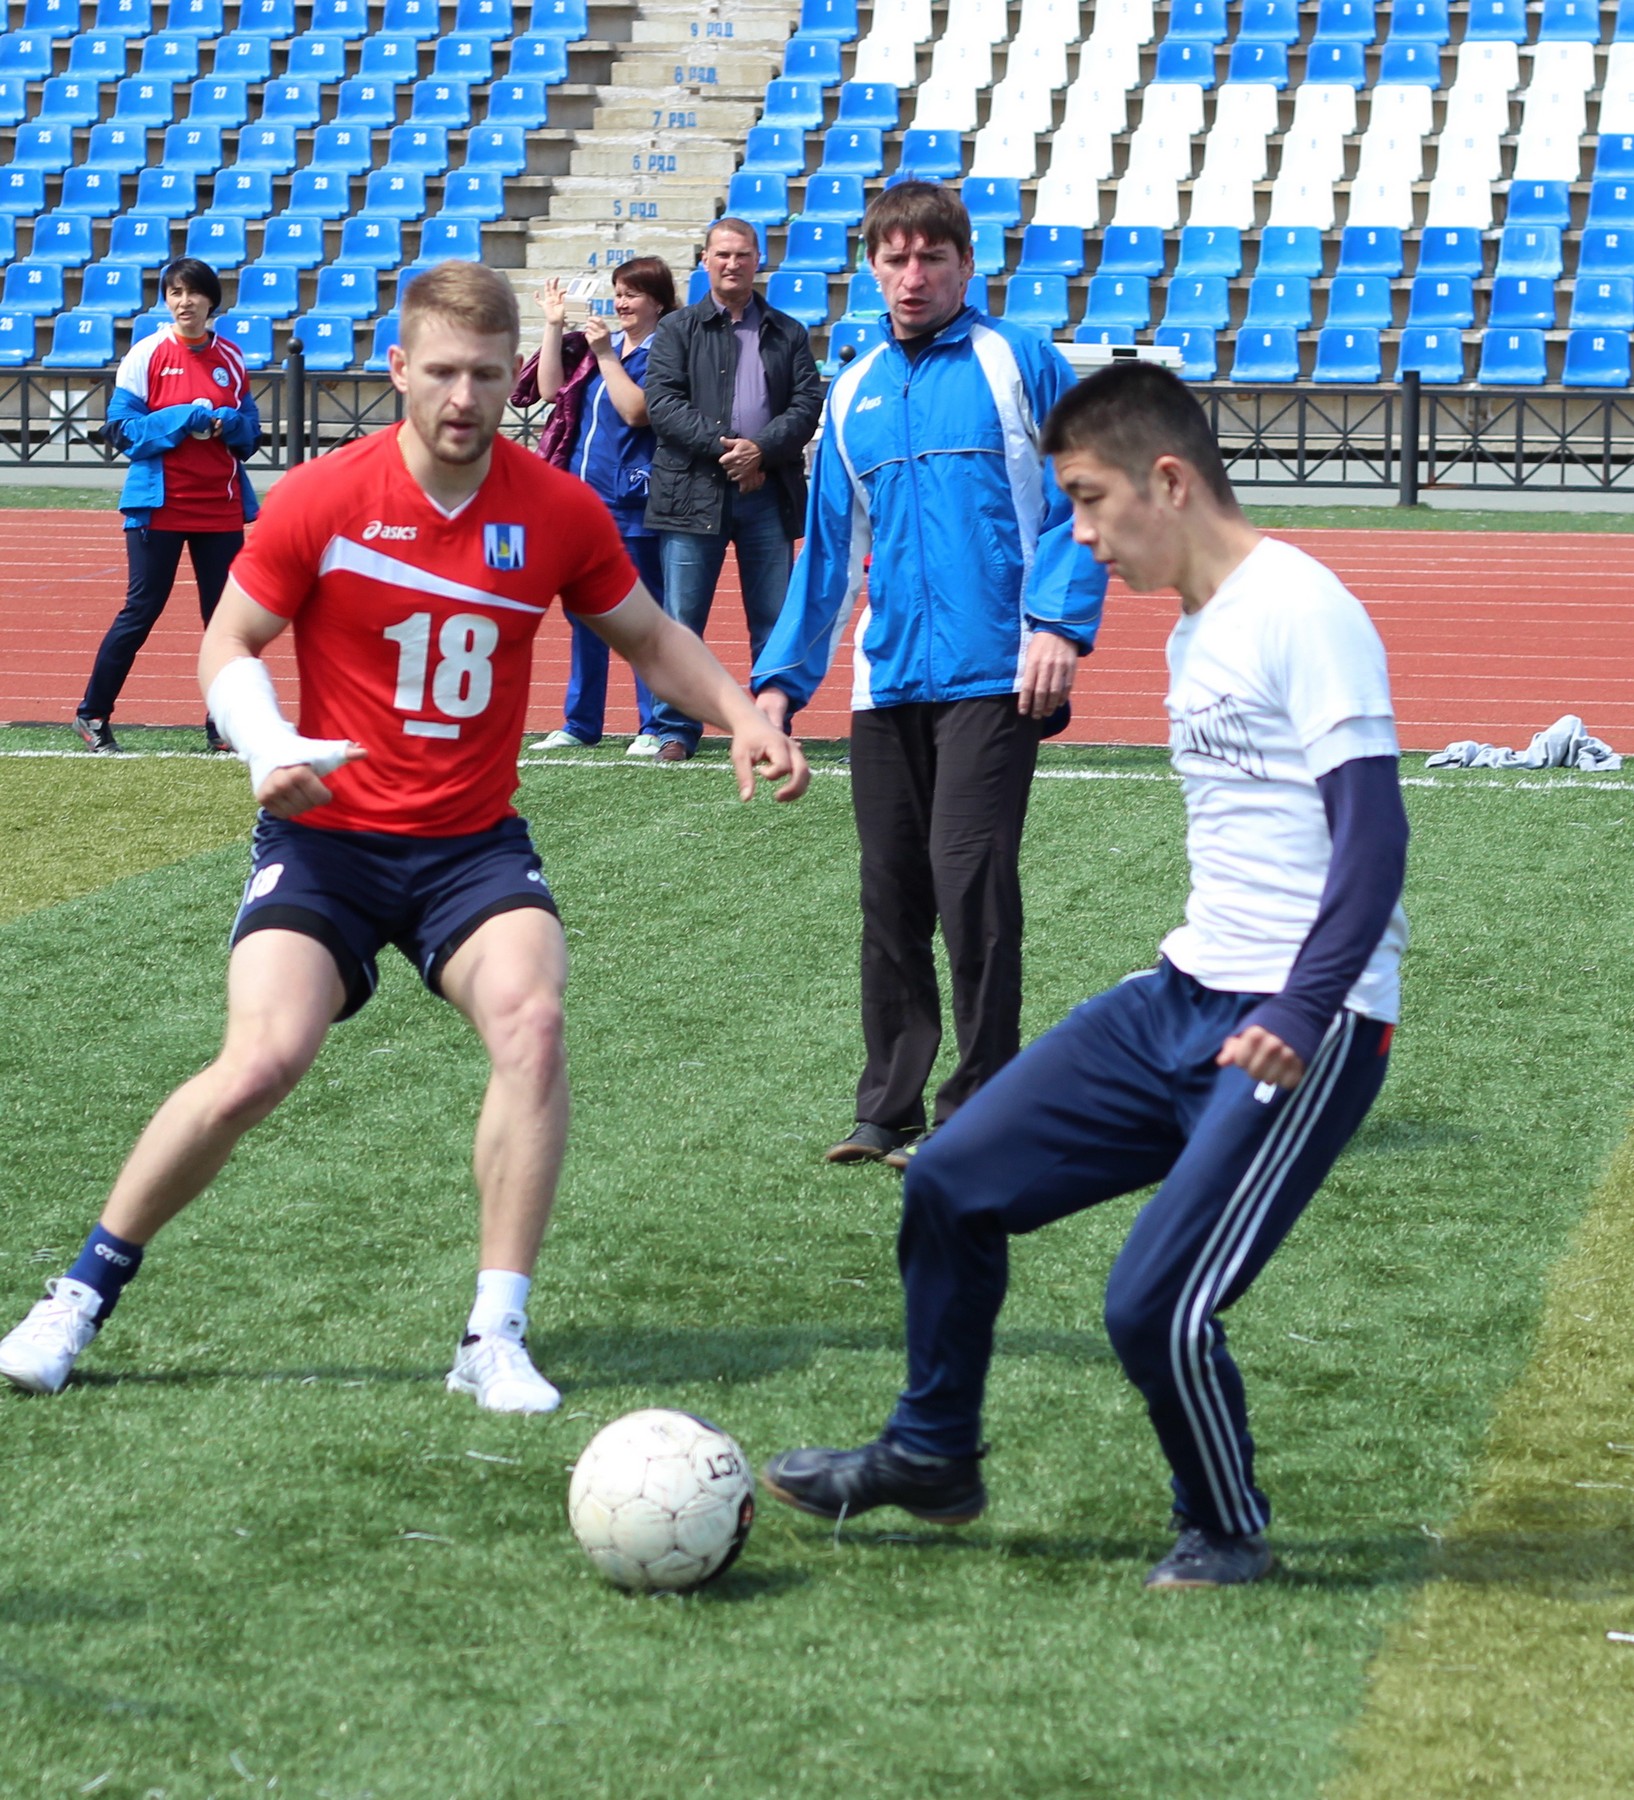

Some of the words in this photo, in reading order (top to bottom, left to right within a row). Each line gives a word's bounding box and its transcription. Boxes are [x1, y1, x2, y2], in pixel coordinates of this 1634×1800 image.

[261, 0, 275, 13] 27
[406, 0, 420, 13] 29
[479, 0, 493, 13] 30
[554, 1, 565, 13] 31
[826, 0, 833, 12] 1
[1194, 2, 1203, 15] 6
[1266, 3, 1274, 15] 7
[690, 22, 699, 37] 9
[706, 22, 734, 37] РЯД
[19, 40, 32, 53] 24
[92, 41, 106, 54] 25
[164, 42, 179, 55] 26
[237, 42, 251, 56] 27
[311, 43, 325, 55] 28
[383, 43, 397, 56] 29
[458, 43, 472, 56] 30
[534, 43, 545, 56] 31
[809, 45, 816, 58] 1
[1182, 47, 1191, 60] 6
[1255, 48, 1264, 61] 7
[674, 65, 683, 83] 8
[65, 84, 79, 98] 25
[140, 85, 154, 99] 26
[213, 86, 227, 100] 27
[286, 87, 299, 99] 28
[361, 87, 375, 100] 29
[435, 87, 449, 100] 30
[512, 87, 524, 100] 31
[791, 86, 798, 99] 1
[865, 87, 874, 100] 2
[653, 110, 662, 127] 7
[668, 111, 697, 127] РЯД
[38, 130, 52, 143] 25
[111, 130, 125, 144] 26
[187, 131, 201, 144] 27
[261, 131, 275, 145] 28
[337, 132, 351, 145] 29
[413, 132, 427, 145] 30
[492, 133, 503, 146] 31
[773, 133, 780, 146] 1
[850, 134, 859, 147] 2
[928, 134, 937, 147] 3
[632, 155, 641, 170] 6
[648, 154, 676, 171] РЯД
[10, 173, 25, 187] 25
[86, 174, 100, 188] 26
[161, 175, 176, 188] 27
[237, 176, 251, 189] 28
[314, 176, 328, 190] 29
[390, 177, 404, 190] 30
[468, 177, 480, 191] 31
[755, 179, 762, 192] 1
[832, 180, 840, 194] 2
[986, 183, 995, 195] 4
[1615, 186, 1627, 200] 12
[613, 200, 622, 215] 5
[629, 202, 657, 217] РЯД
[56, 222, 71, 235] 26
[134, 222, 149, 236] 27
[211, 223, 225, 237] 28
[288, 224, 302, 237] 29
[365, 224, 380, 238] 30
[446, 224, 458, 238] 31
[814, 227, 823, 241] 2
[1050, 228, 1058, 242] 5
[970, 230, 979, 243] 4
[1129, 231, 1138, 244] 6
[1206, 231, 1216, 244] 7
[1287, 231, 1295, 244] 8
[1368, 231, 1376, 245] 9
[1606, 234, 1618, 248] 12
[588, 252, 597, 268] 4
[28, 270, 42, 284] 26
[106, 271, 121, 285] 27
[263, 272, 277, 286] 29
[341, 273, 356, 287] 30
[794, 278, 803, 293] 2
[1034, 281, 1043, 295] 5
[1115, 282, 1124, 296] 6
[1195, 284, 1202, 297] 7
[1276, 283, 1285, 297] 8
[1356, 283, 1365, 297] 9
[1599, 284, 1611, 298] 12
[79, 320, 93, 334] 27
[236, 320, 250, 334] 29
[317, 323, 332, 337] 30
[857, 328, 866, 342] 3
[1100, 332, 1109, 345] 6
[1182, 332, 1191, 347] 7
[1263, 333, 1272, 347] 8
[1345, 334, 1354, 348] 9
[1593, 337, 1605, 351] 12
[383, 612, 499, 718] 18
[246, 863, 284, 905] 18
